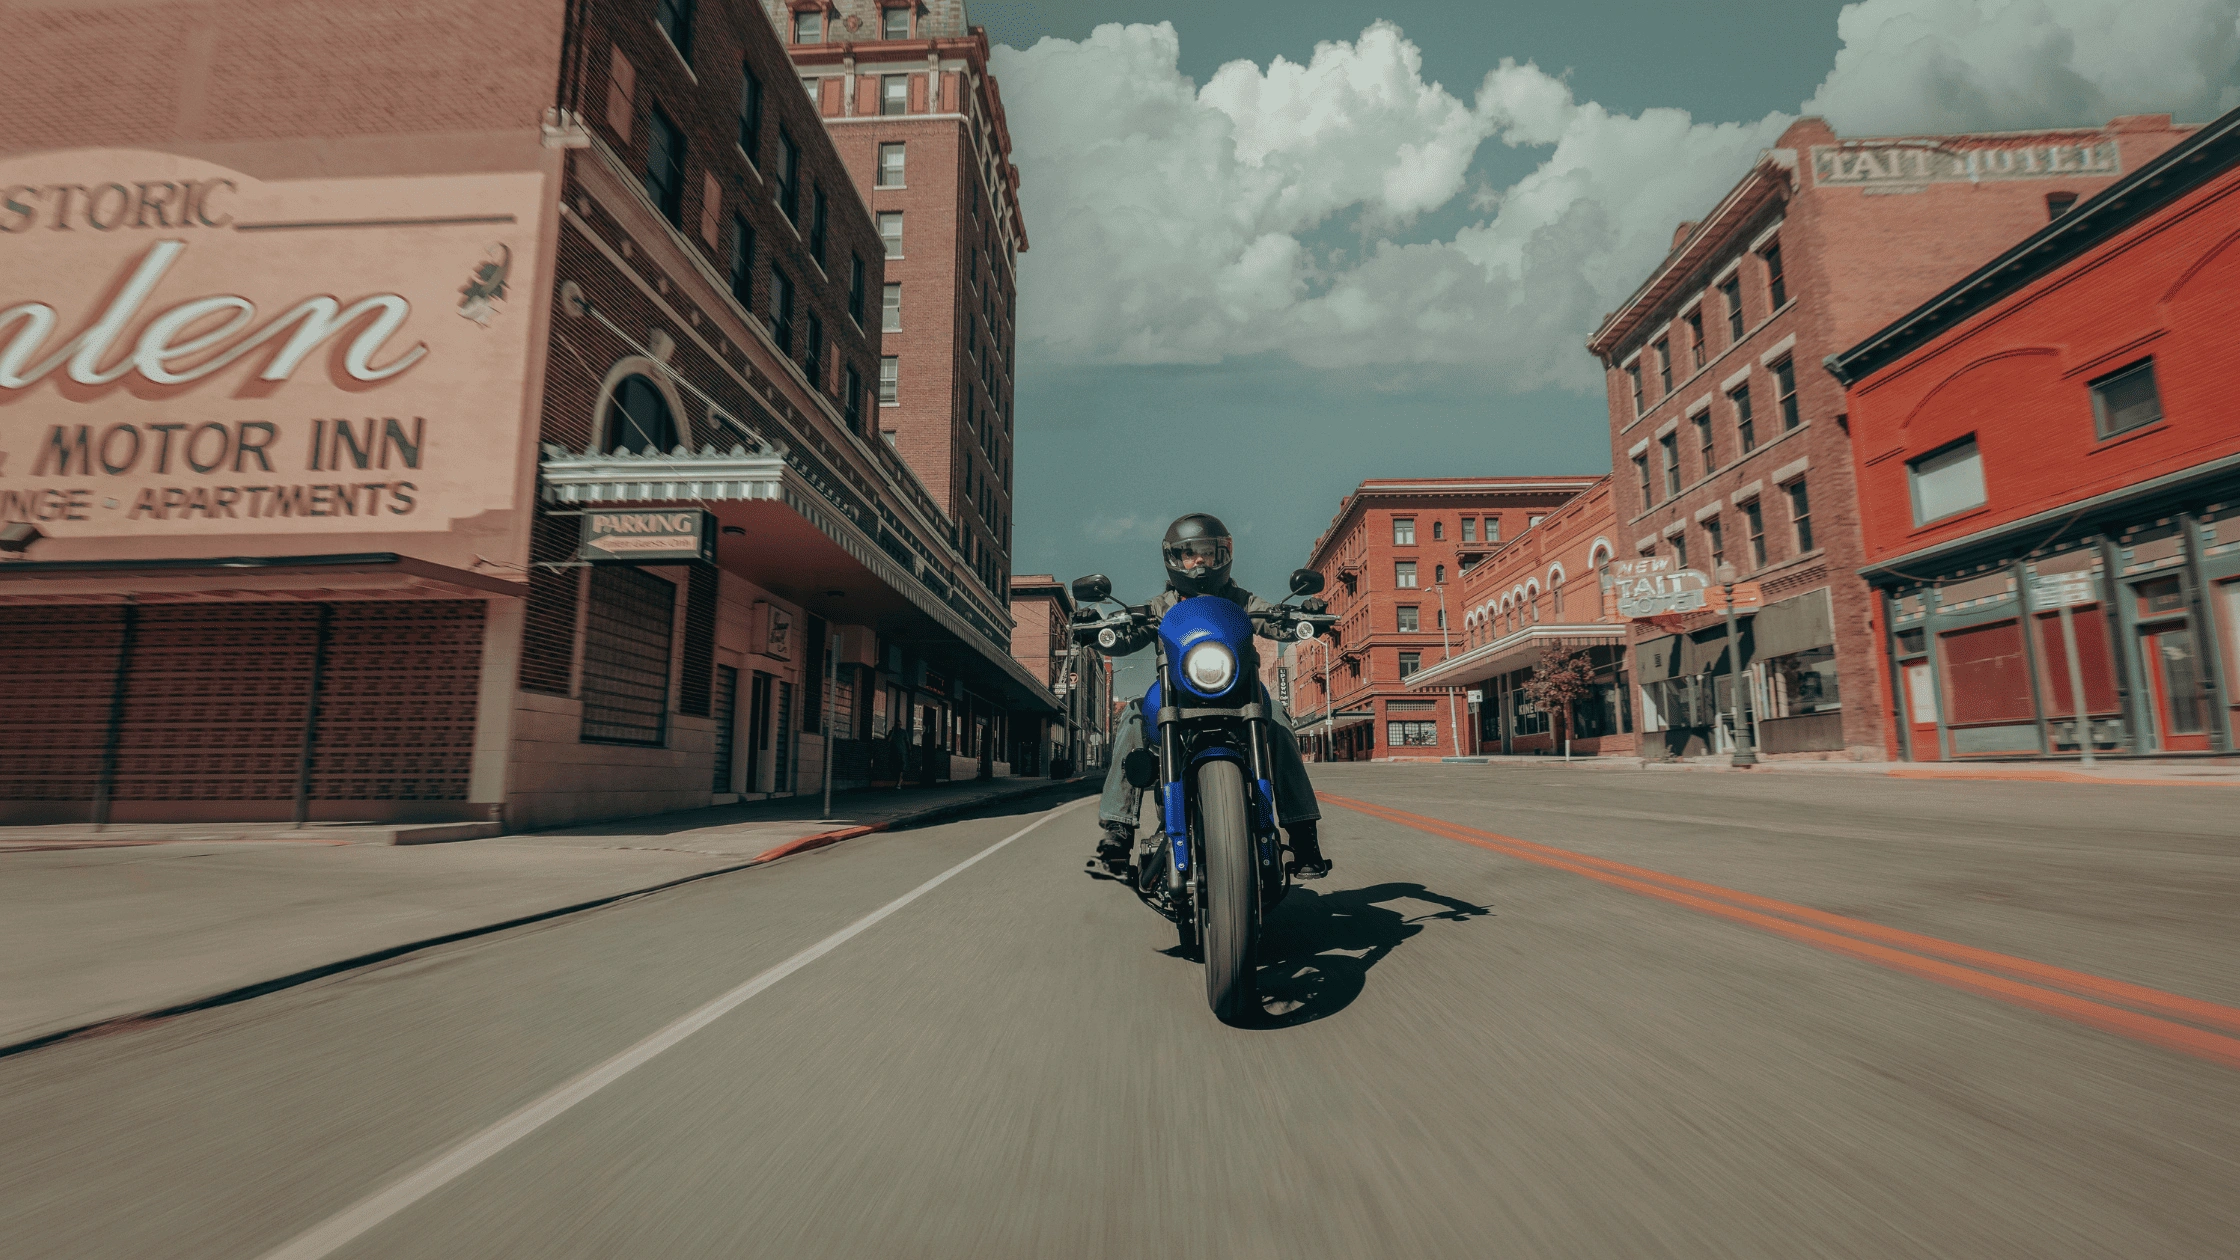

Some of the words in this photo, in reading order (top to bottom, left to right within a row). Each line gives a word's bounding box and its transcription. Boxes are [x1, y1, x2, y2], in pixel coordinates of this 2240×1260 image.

[1821, 149, 1935, 181] TAIT
[29, 419, 281, 476] MOTOR
[305, 416, 427, 472] INN
[126, 481, 420, 520] APARTMENTS
[592, 513, 692, 533] PARKING
[1618, 559, 1668, 575] NEW
[1615, 572, 1687, 599] TAIT
